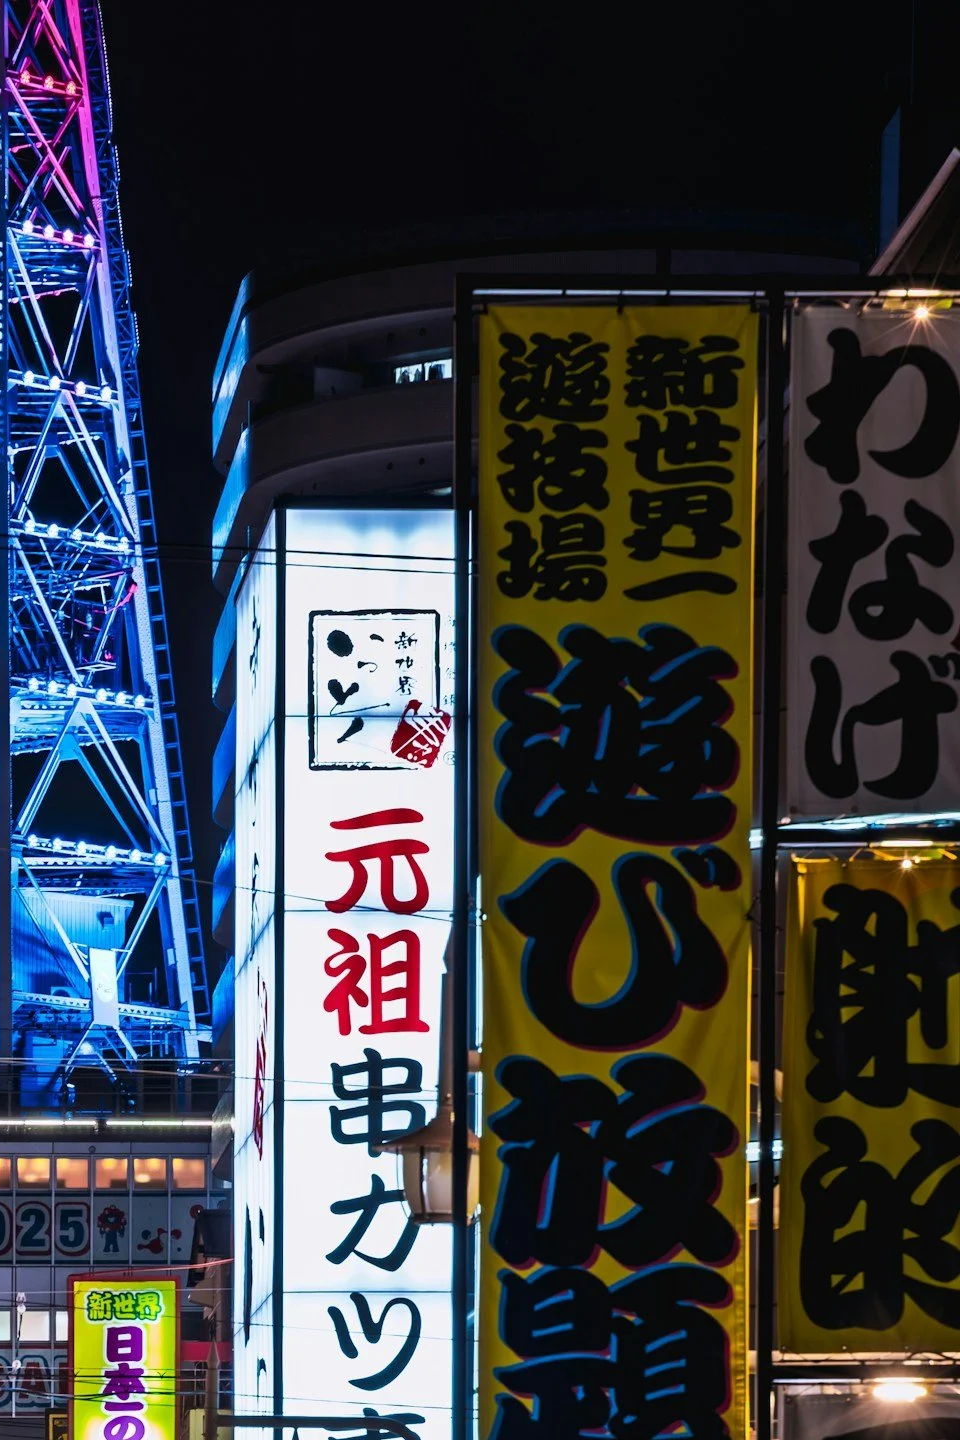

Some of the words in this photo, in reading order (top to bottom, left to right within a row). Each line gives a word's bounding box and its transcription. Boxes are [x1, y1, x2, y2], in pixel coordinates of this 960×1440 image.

[497, 331, 610, 602] 遊技場
[623, 334, 746, 601] 新世界一
[804, 327, 960, 799] わなげ
[87, 1290, 163, 1322] 新世界
